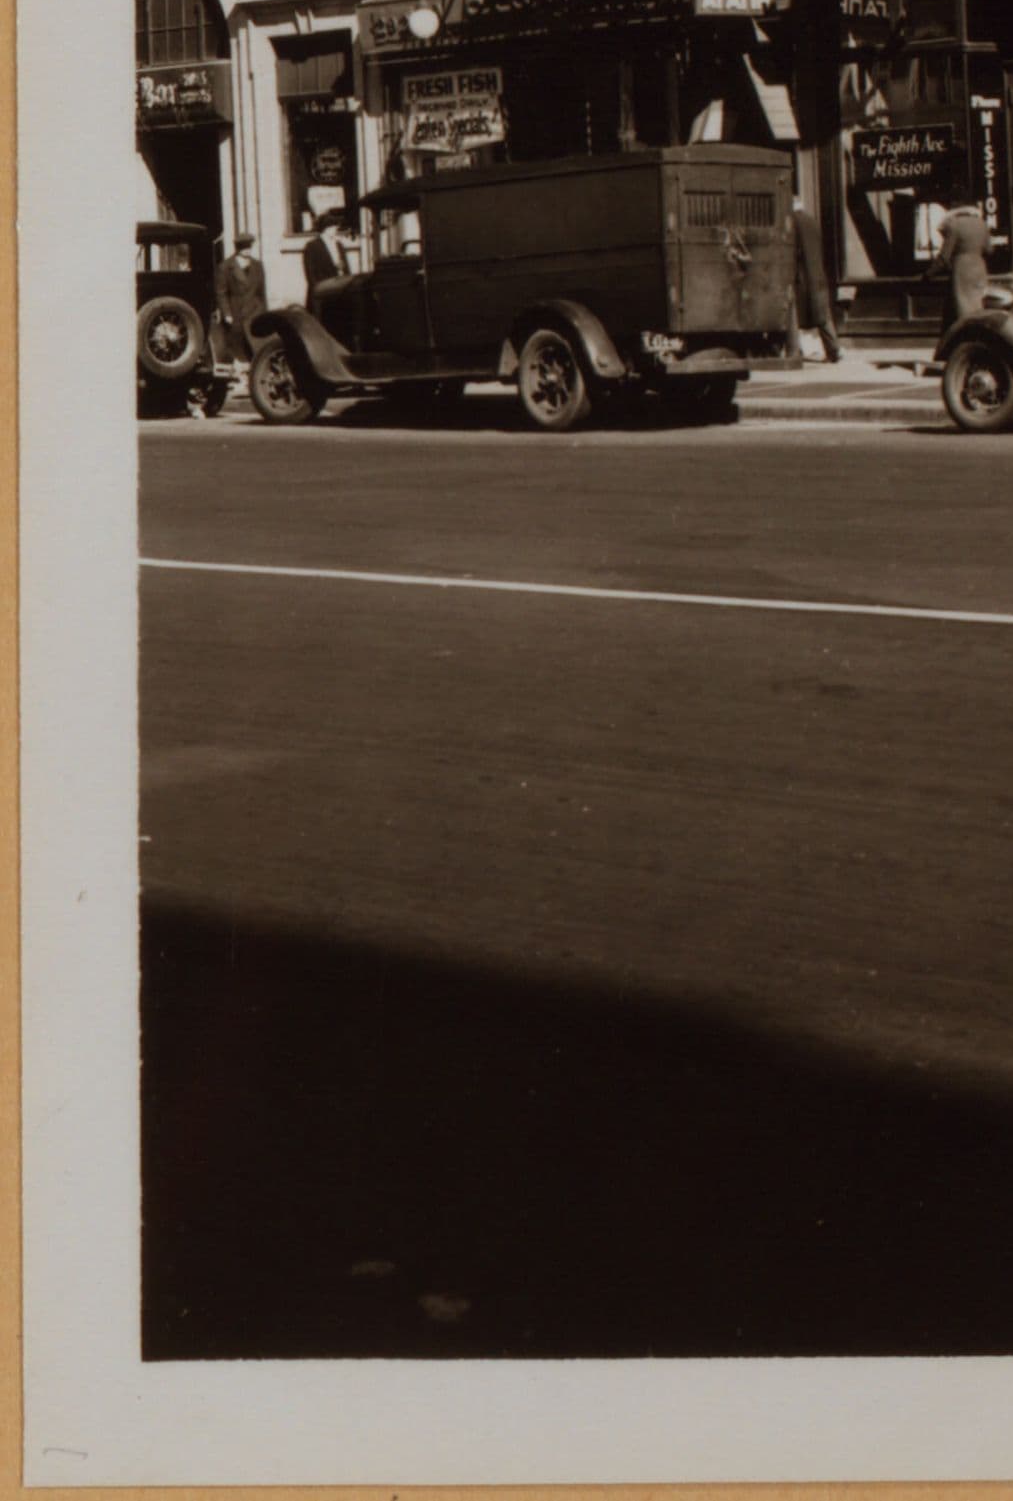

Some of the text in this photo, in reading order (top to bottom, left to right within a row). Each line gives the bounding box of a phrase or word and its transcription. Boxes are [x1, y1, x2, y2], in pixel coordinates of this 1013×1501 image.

[407, 73, 498, 100] FRESH FISH
[877, 134, 920, 164] Eighth
[872, 158, 933, 179] Mission
[980, 110, 998, 229] MISSION
